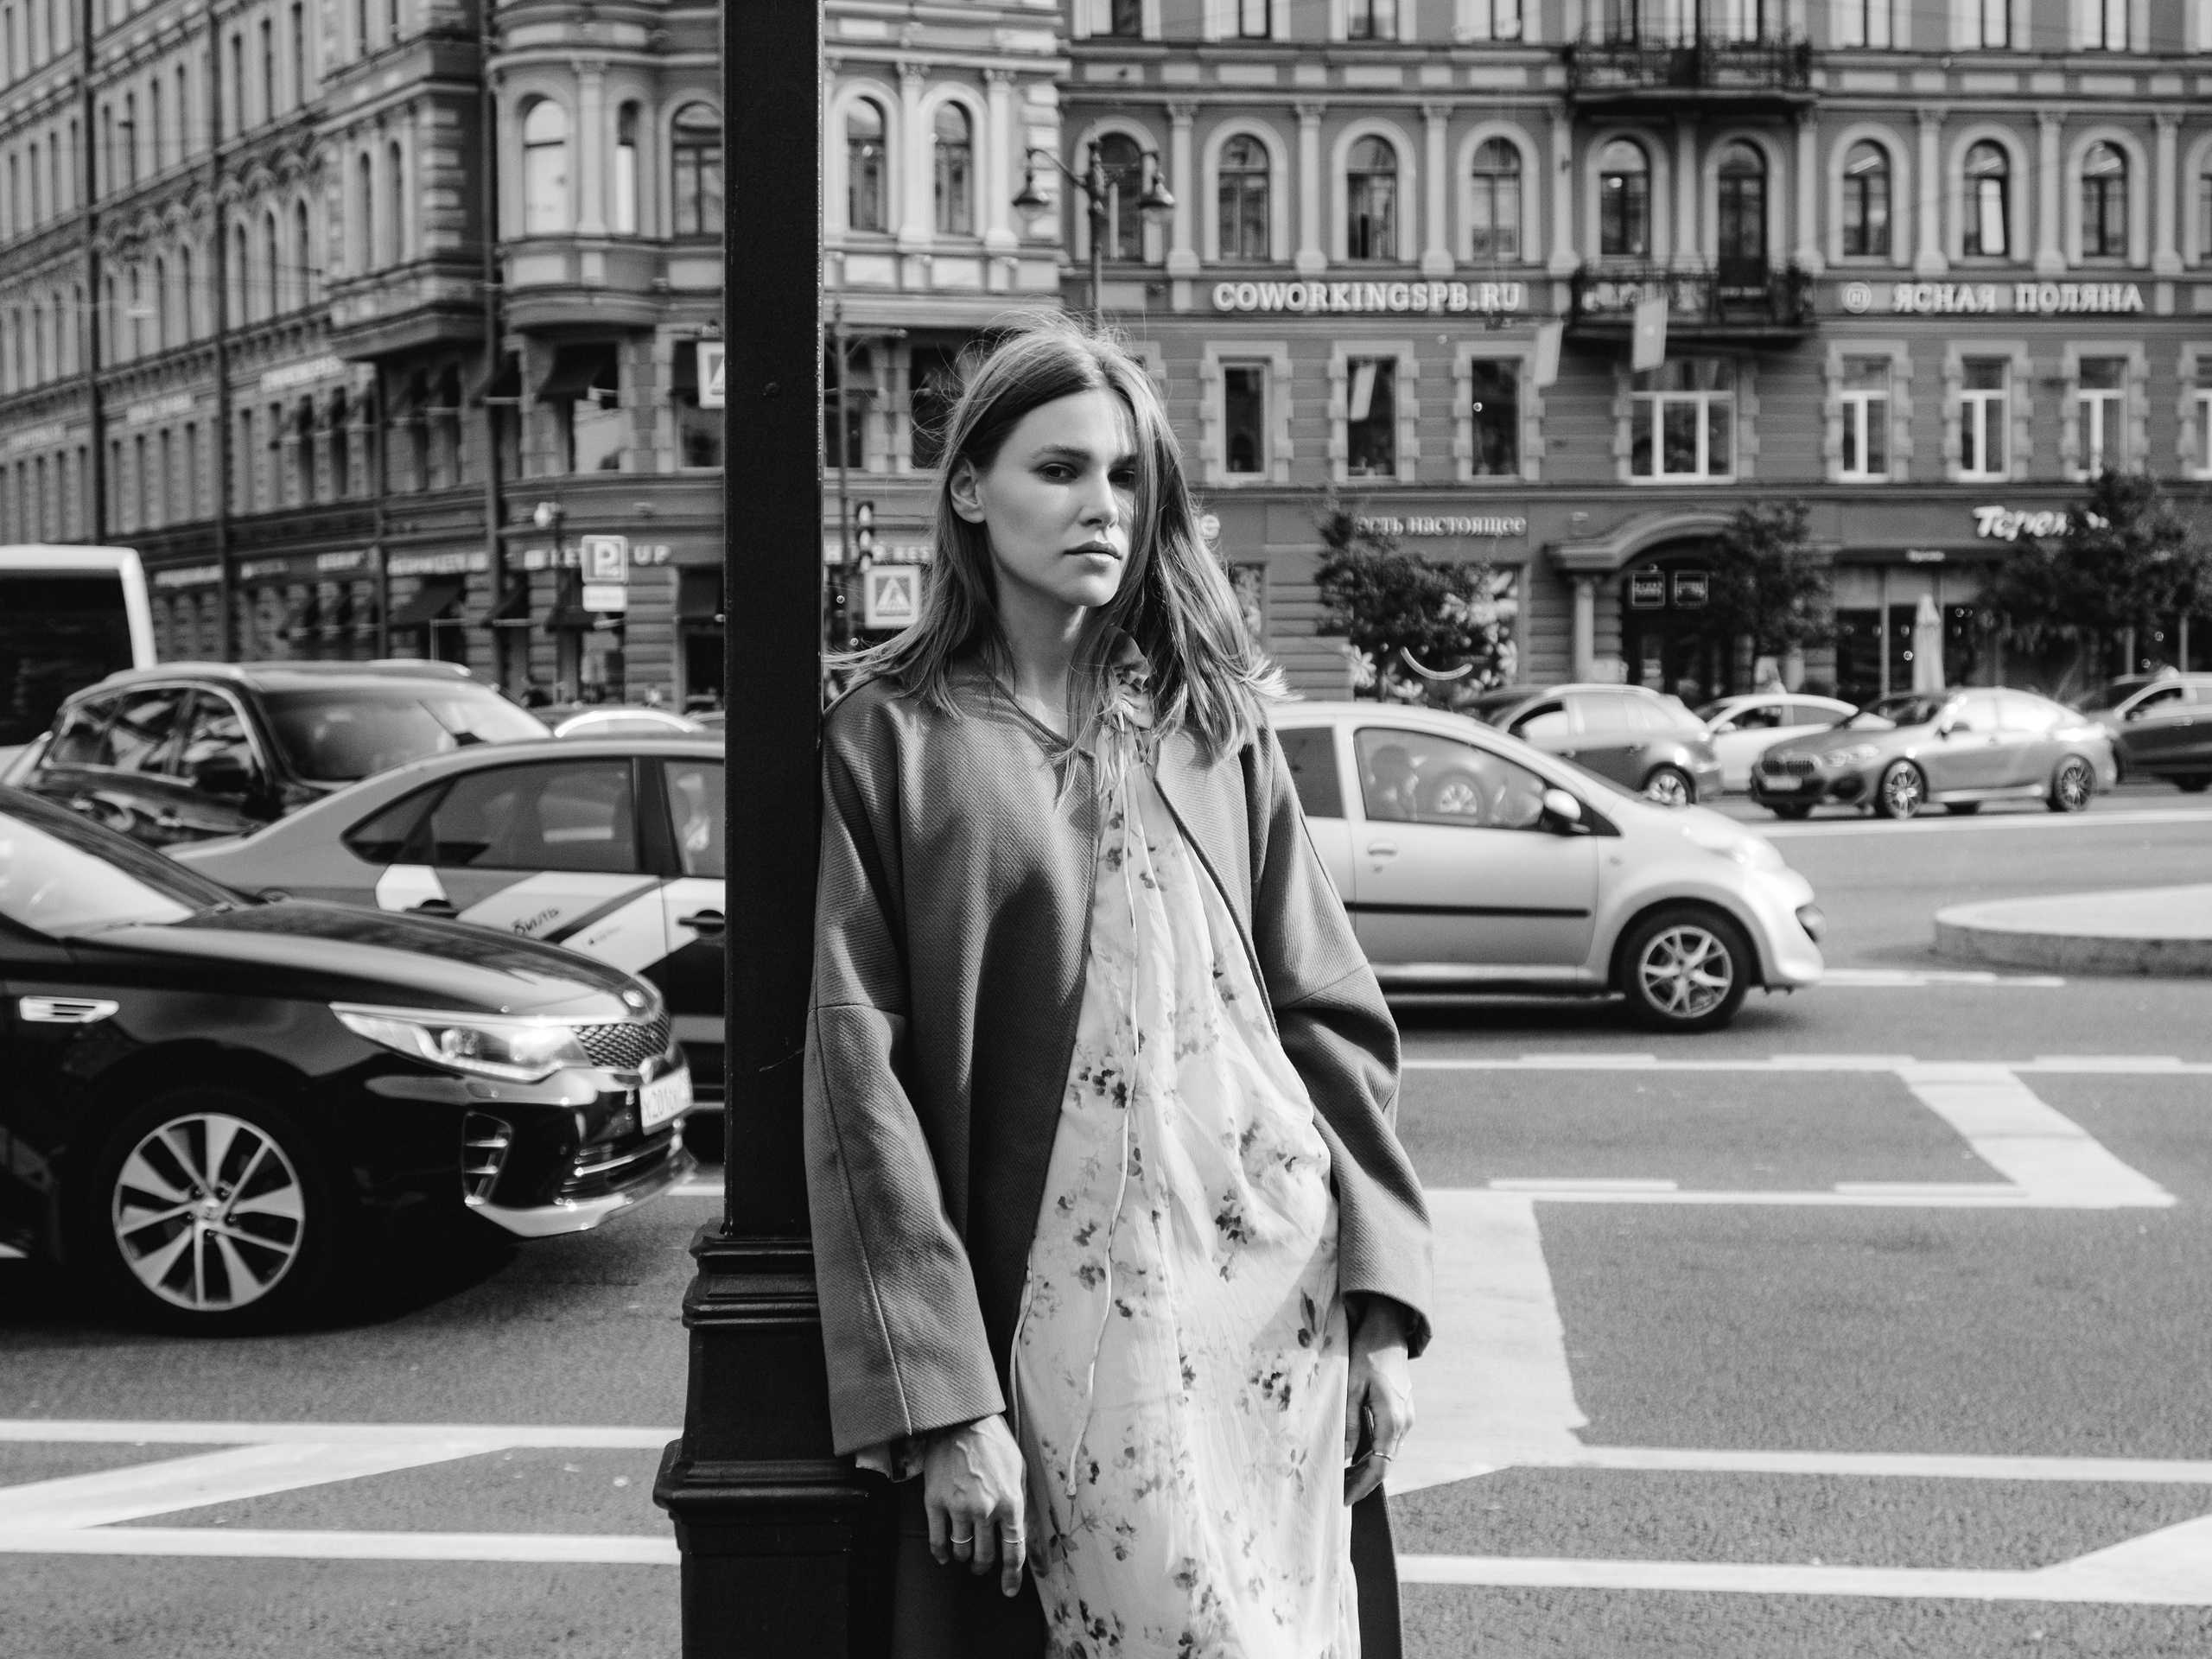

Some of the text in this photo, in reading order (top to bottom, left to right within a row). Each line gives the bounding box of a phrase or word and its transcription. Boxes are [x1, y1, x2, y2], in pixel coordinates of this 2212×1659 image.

[1212, 282, 1521, 312] COWORKINGSPB.RU
[1893, 283, 2145, 313] ЯСНАЯ ПОЛЯНА
[1973, 505, 2113, 542] Терем
[512, 908, 559, 937] биль
